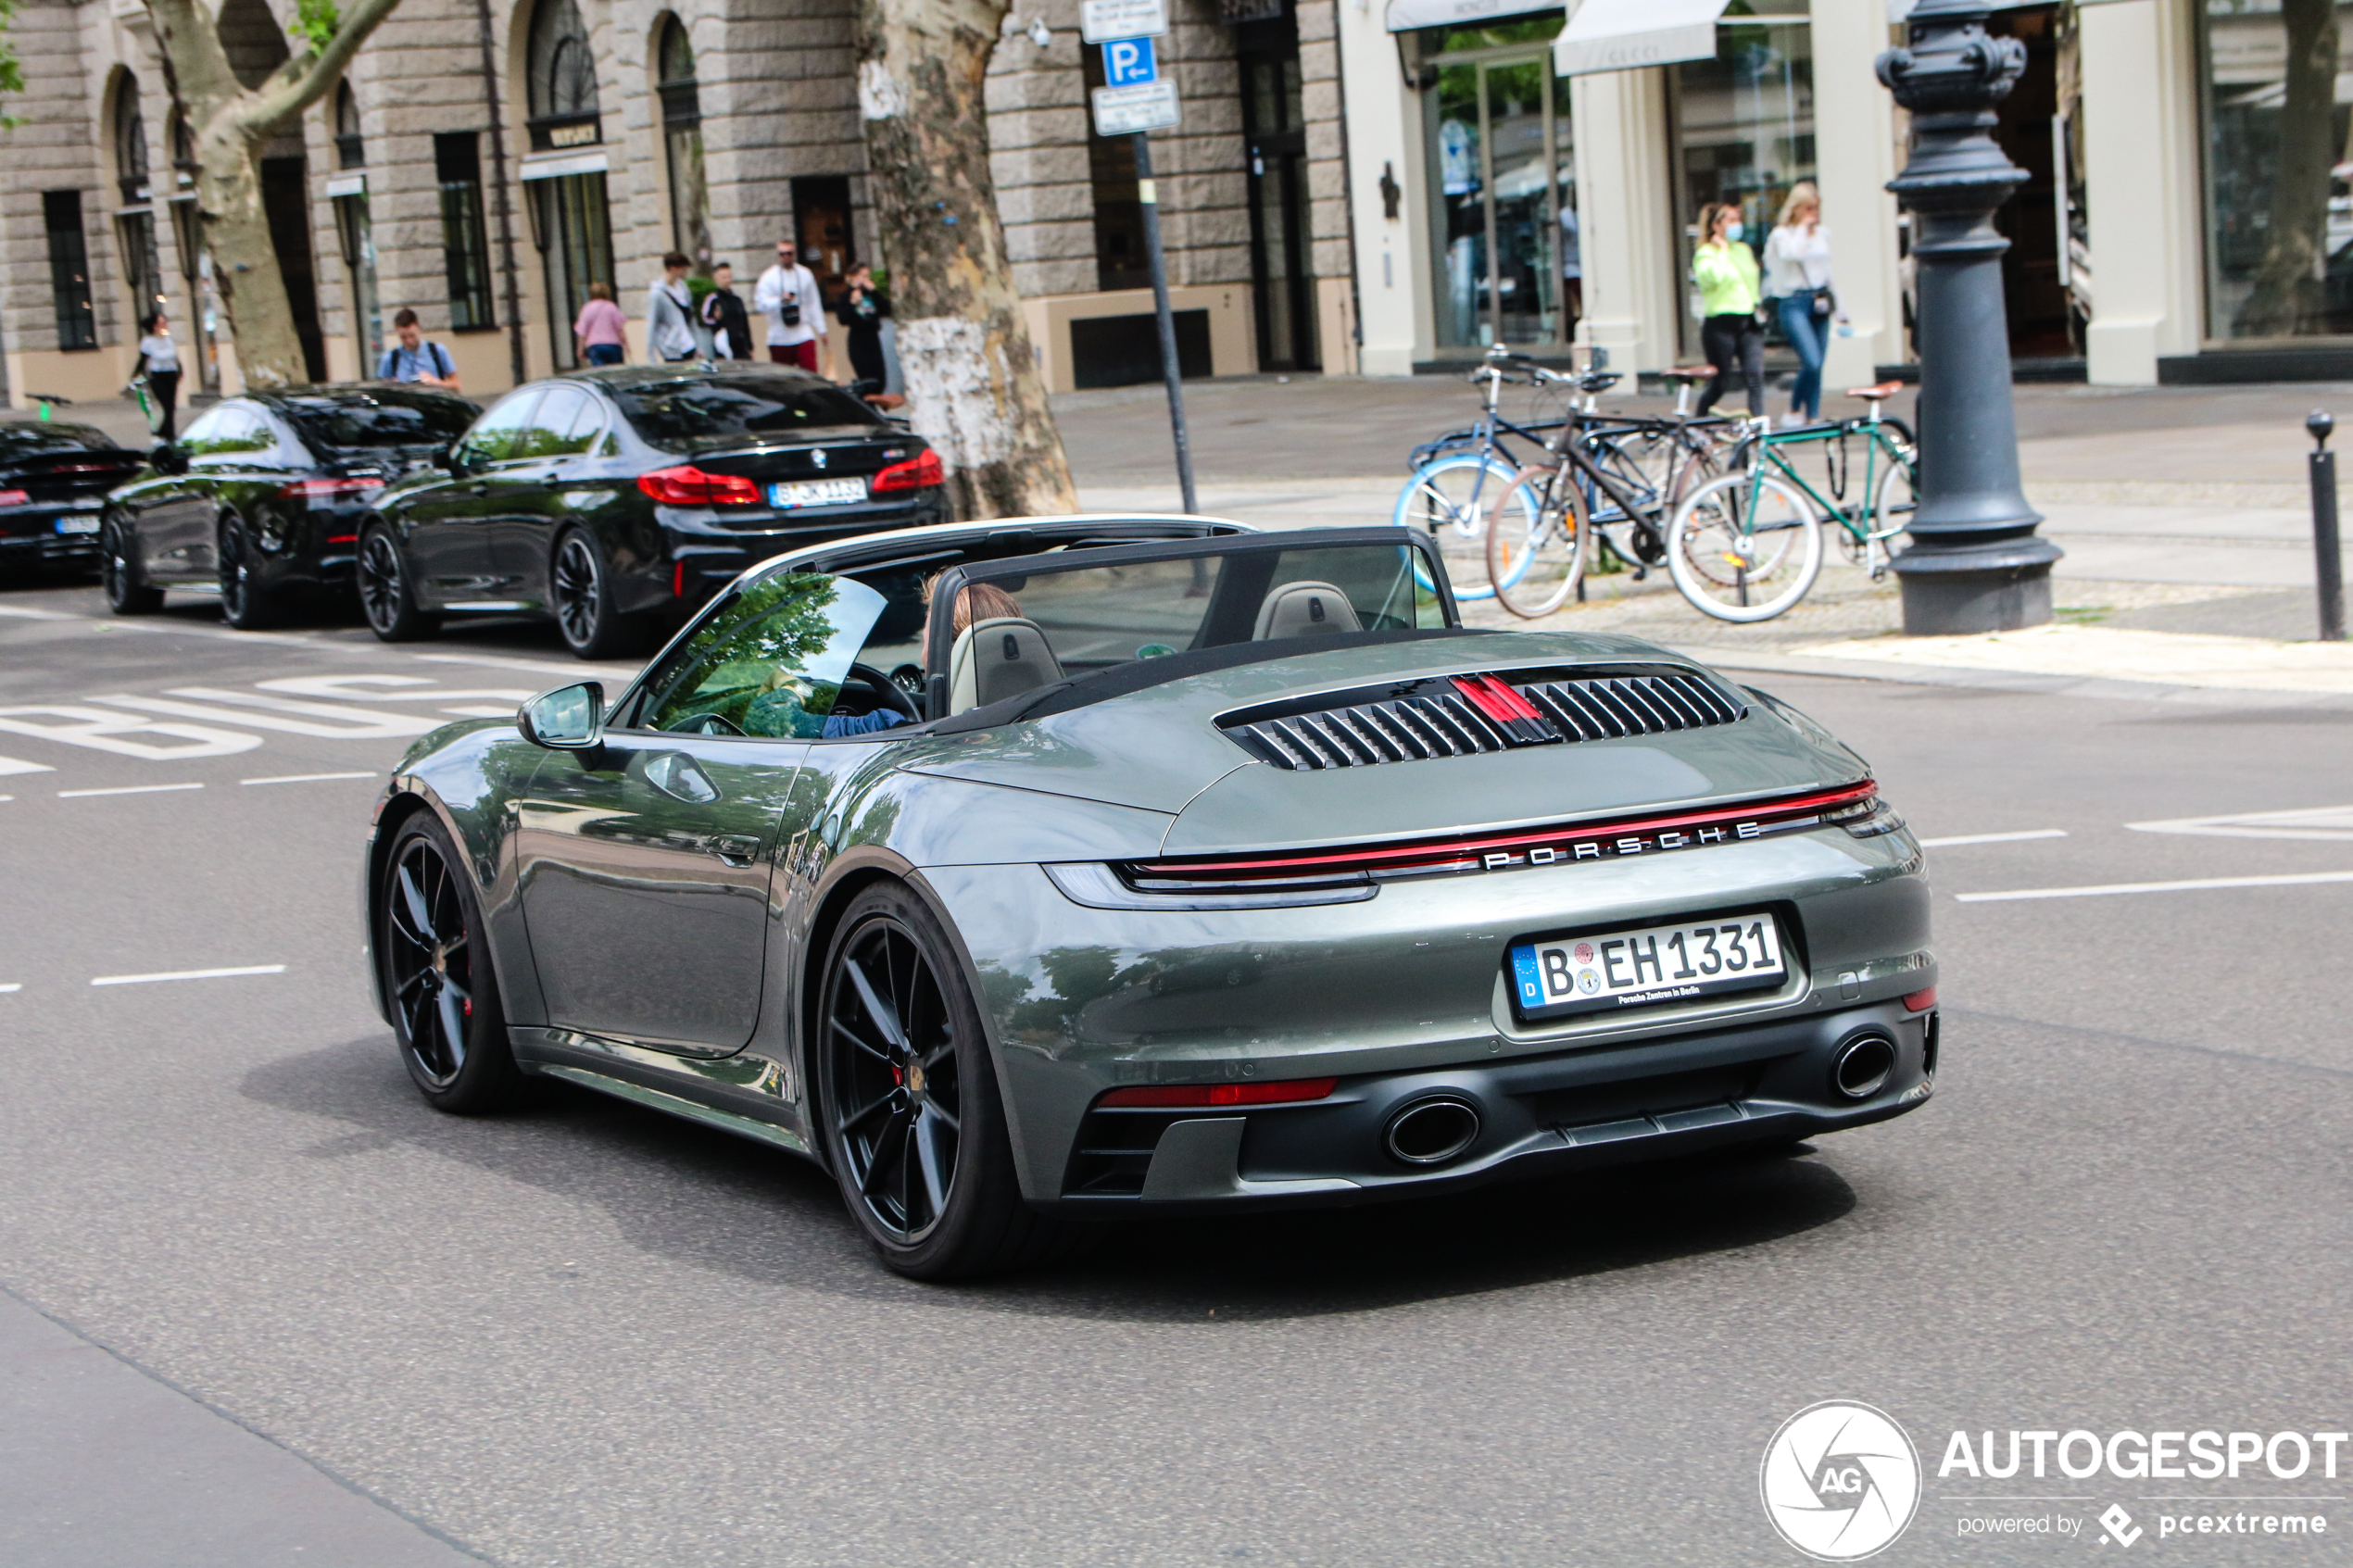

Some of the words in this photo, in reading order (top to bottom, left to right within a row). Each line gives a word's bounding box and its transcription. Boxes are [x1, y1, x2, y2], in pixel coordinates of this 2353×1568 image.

[1111, 42, 1140, 82] P
[0, 673, 576, 761] BUS
[1484, 822, 1760, 871] PORSCHE
[1525, 983, 1537, 997] D
[1541, 948, 1574, 997] B
[1618, 994, 1646, 1004] Porsche
[1645, 989, 1672, 1000] Zentren
[1673, 988, 1680, 997] in
[1680, 985, 1700, 996] Berlin
